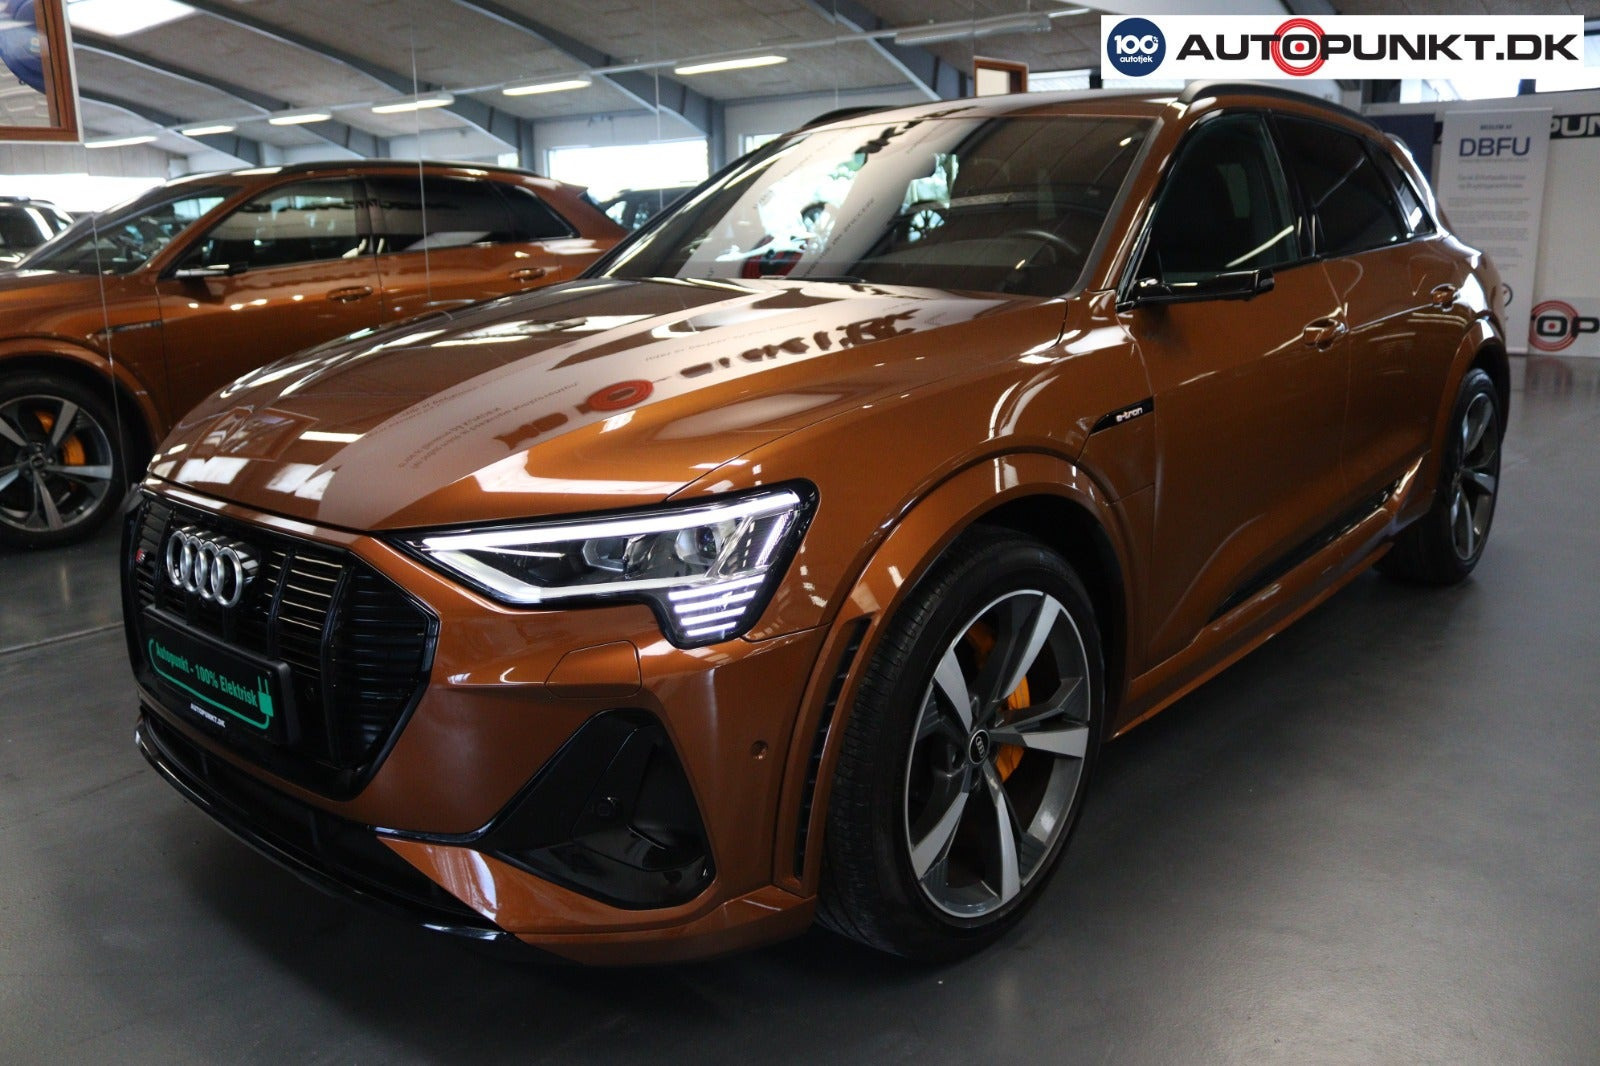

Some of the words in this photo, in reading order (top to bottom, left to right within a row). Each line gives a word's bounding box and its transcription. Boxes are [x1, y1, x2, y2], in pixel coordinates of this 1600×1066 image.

[1459, 136, 1531, 157] DBFU
[1115, 407, 1143, 422] e-tron
[155, 641, 190, 674] Autopunkt
[194, 663, 219, 689] 100%
[219, 674, 258, 707] Elektrisk
